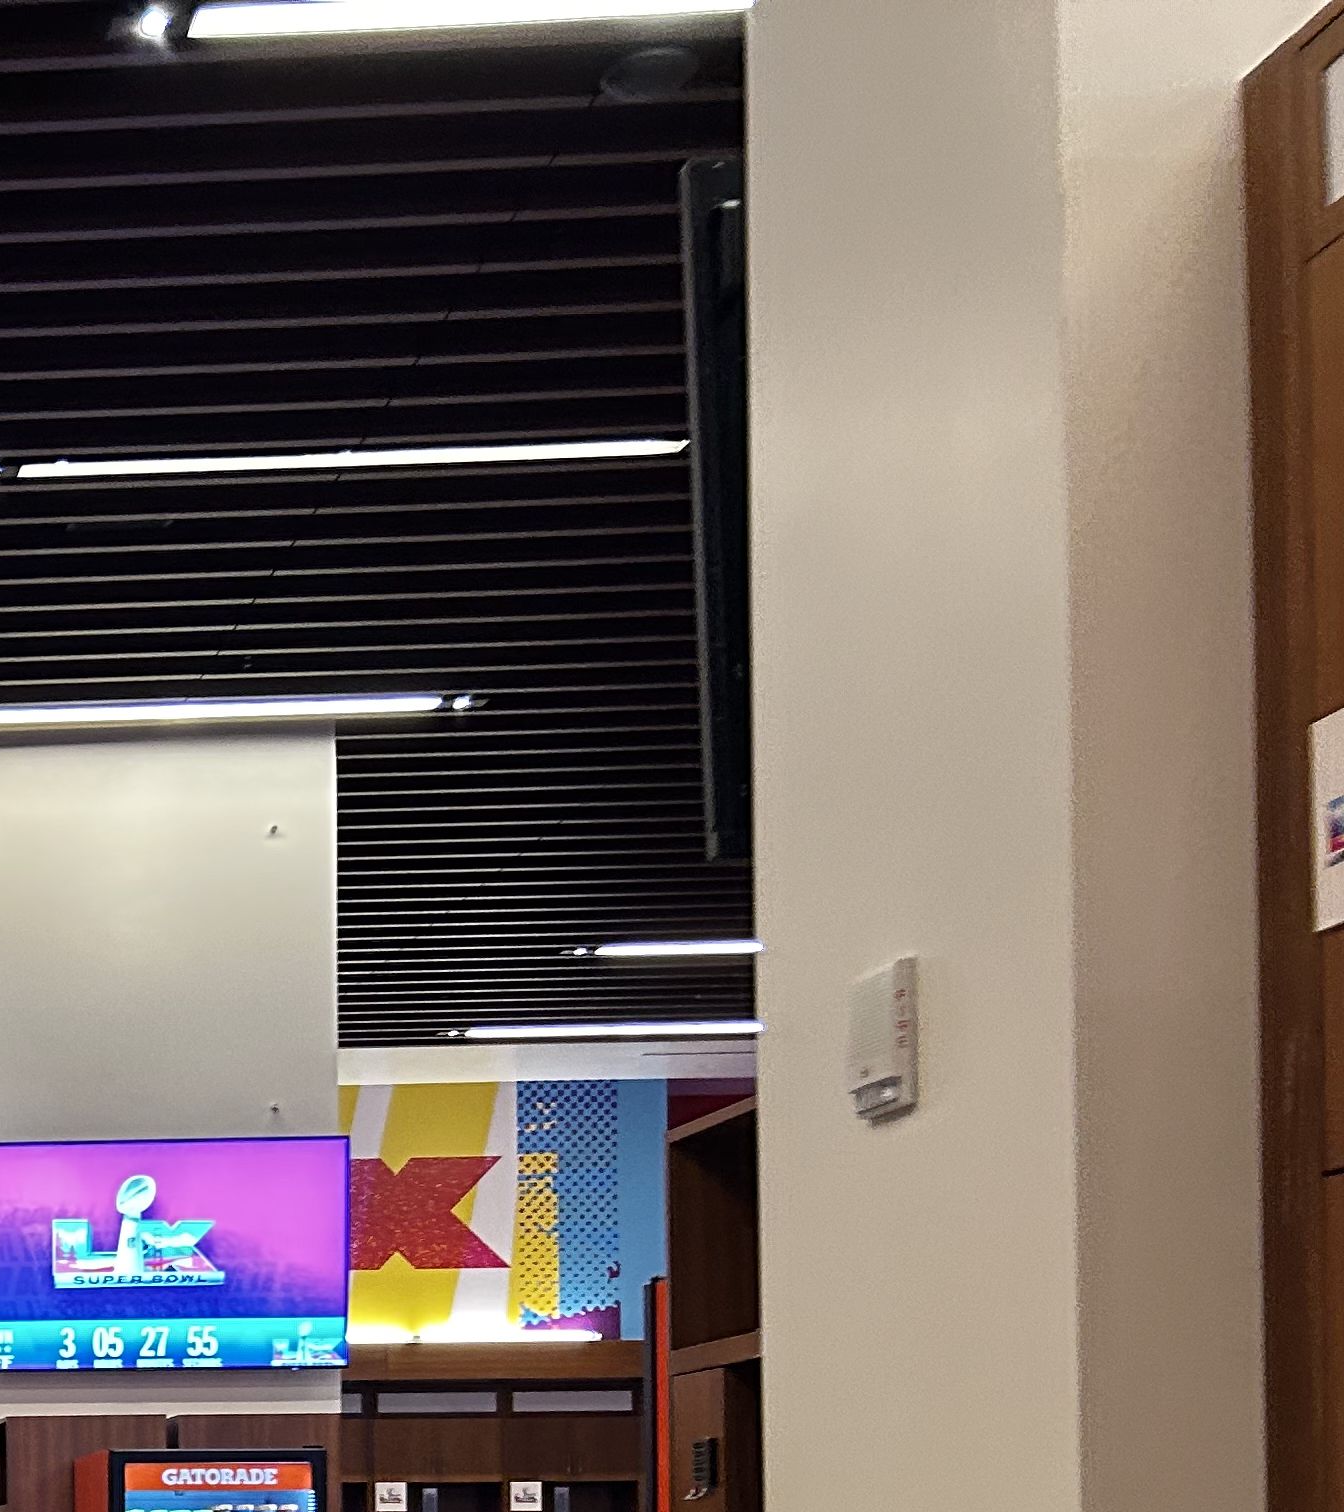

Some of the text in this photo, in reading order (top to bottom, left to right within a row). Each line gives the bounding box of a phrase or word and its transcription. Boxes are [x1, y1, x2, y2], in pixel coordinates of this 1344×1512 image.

[73, 1274, 207, 1285] SUPER BOWL
[58, 1325, 219, 1358] 3 05 27 55
[161, 1468, 278, 1485] GATORADE
